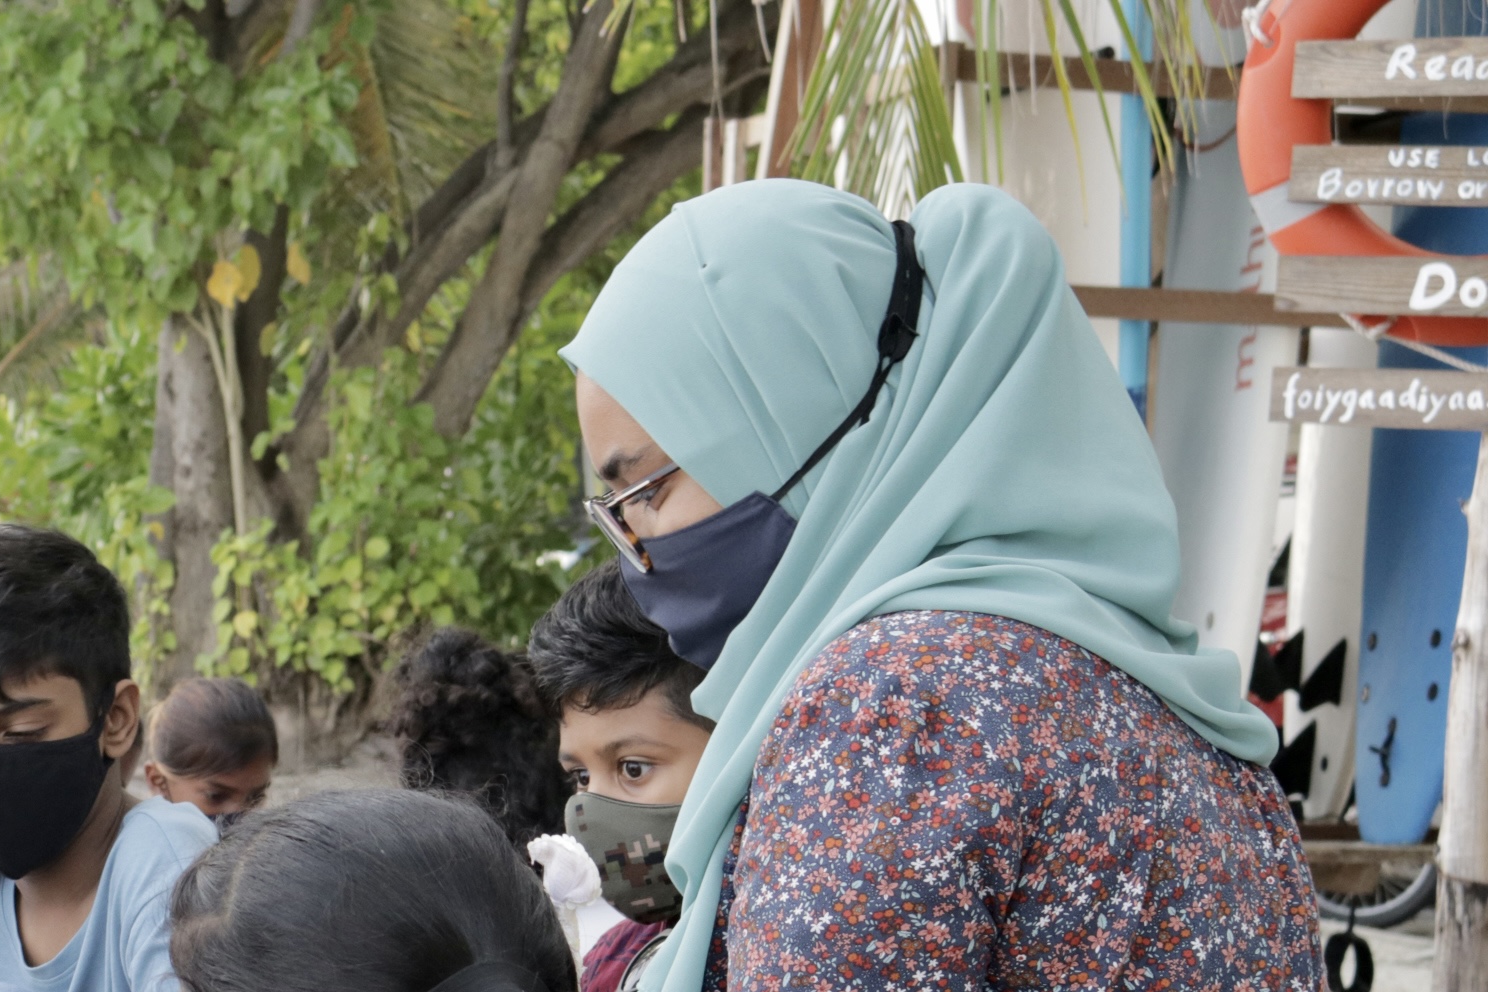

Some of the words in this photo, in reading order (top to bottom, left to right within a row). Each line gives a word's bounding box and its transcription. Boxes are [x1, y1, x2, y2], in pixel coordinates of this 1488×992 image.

[1388, 149, 1440, 168] USE
[1317, 167, 1443, 200] Borrow
[1283, 371, 1488, 423] foiygaadiyaa
